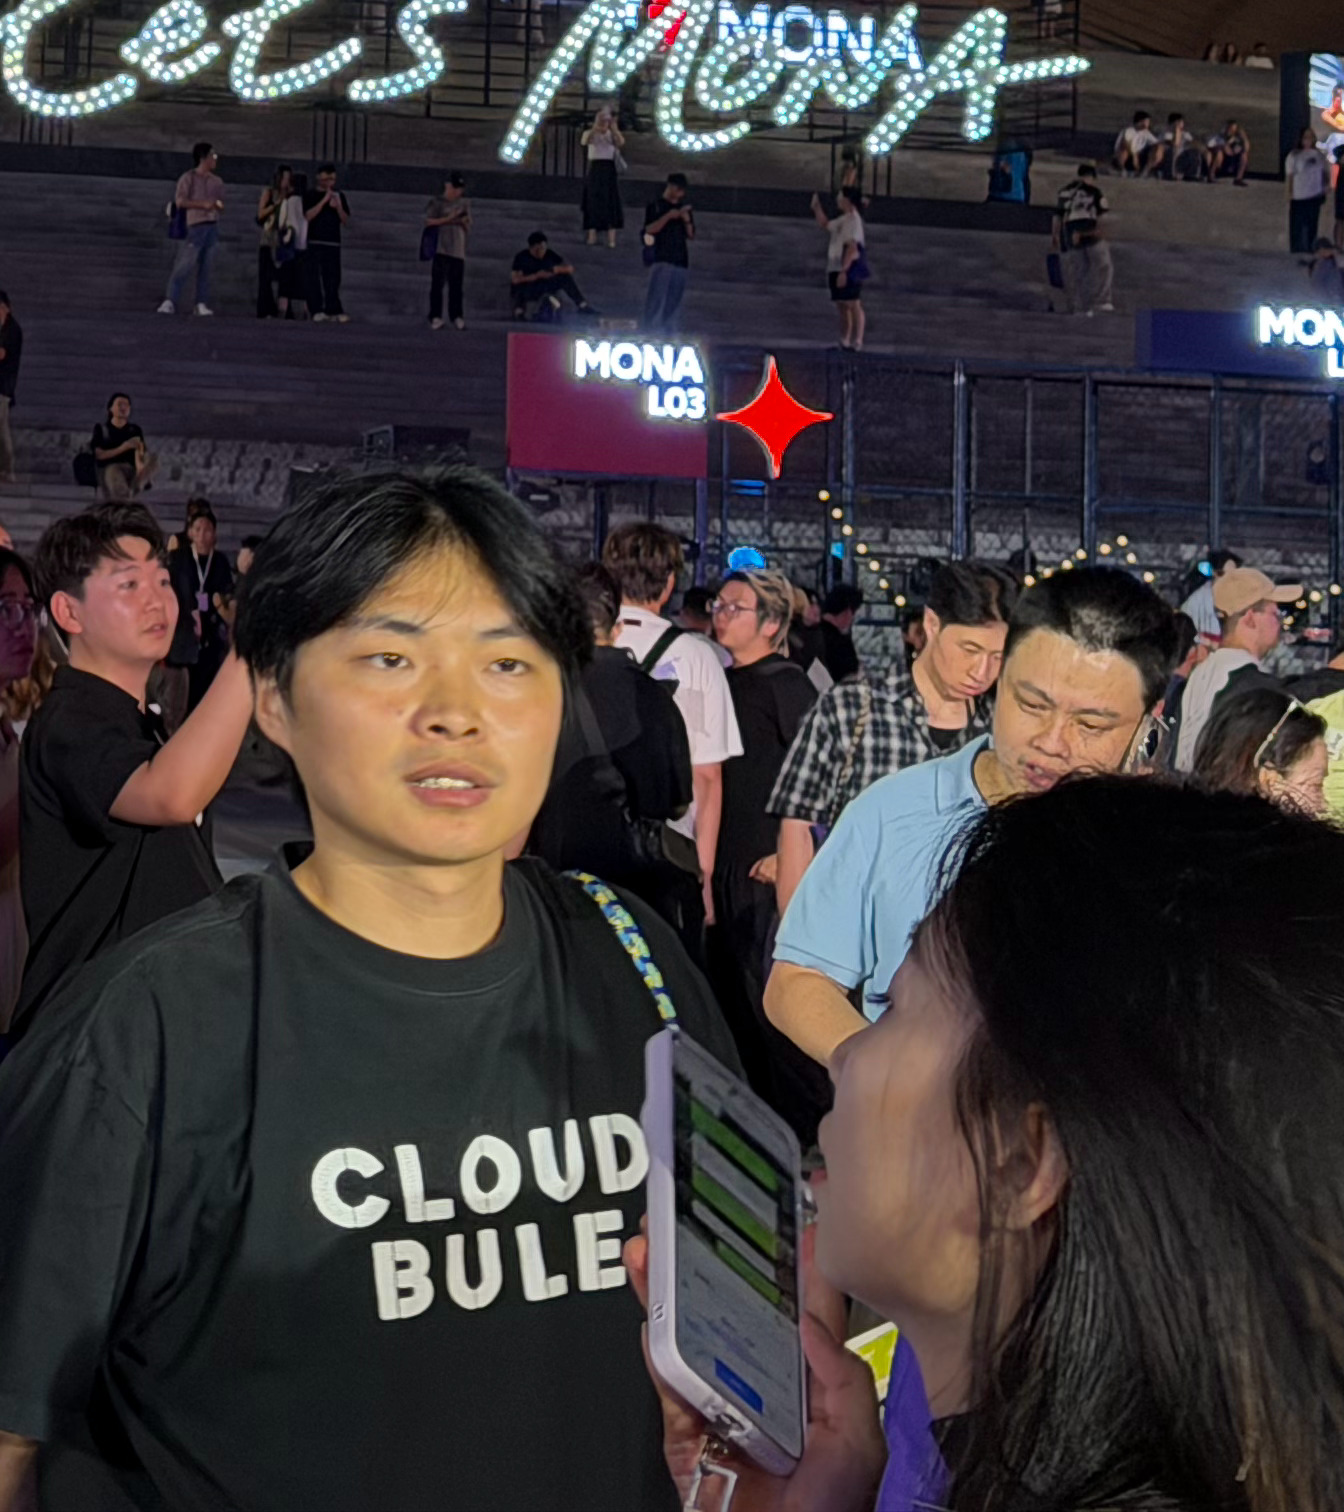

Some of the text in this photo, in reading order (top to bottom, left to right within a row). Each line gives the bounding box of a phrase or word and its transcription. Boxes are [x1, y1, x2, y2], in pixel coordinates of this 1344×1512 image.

[575, 340, 704, 383] MONA
[648, 385, 706, 419] L03
[312, 1113, 651, 1229] CLOUD
[371, 1209, 627, 1321] BULE
